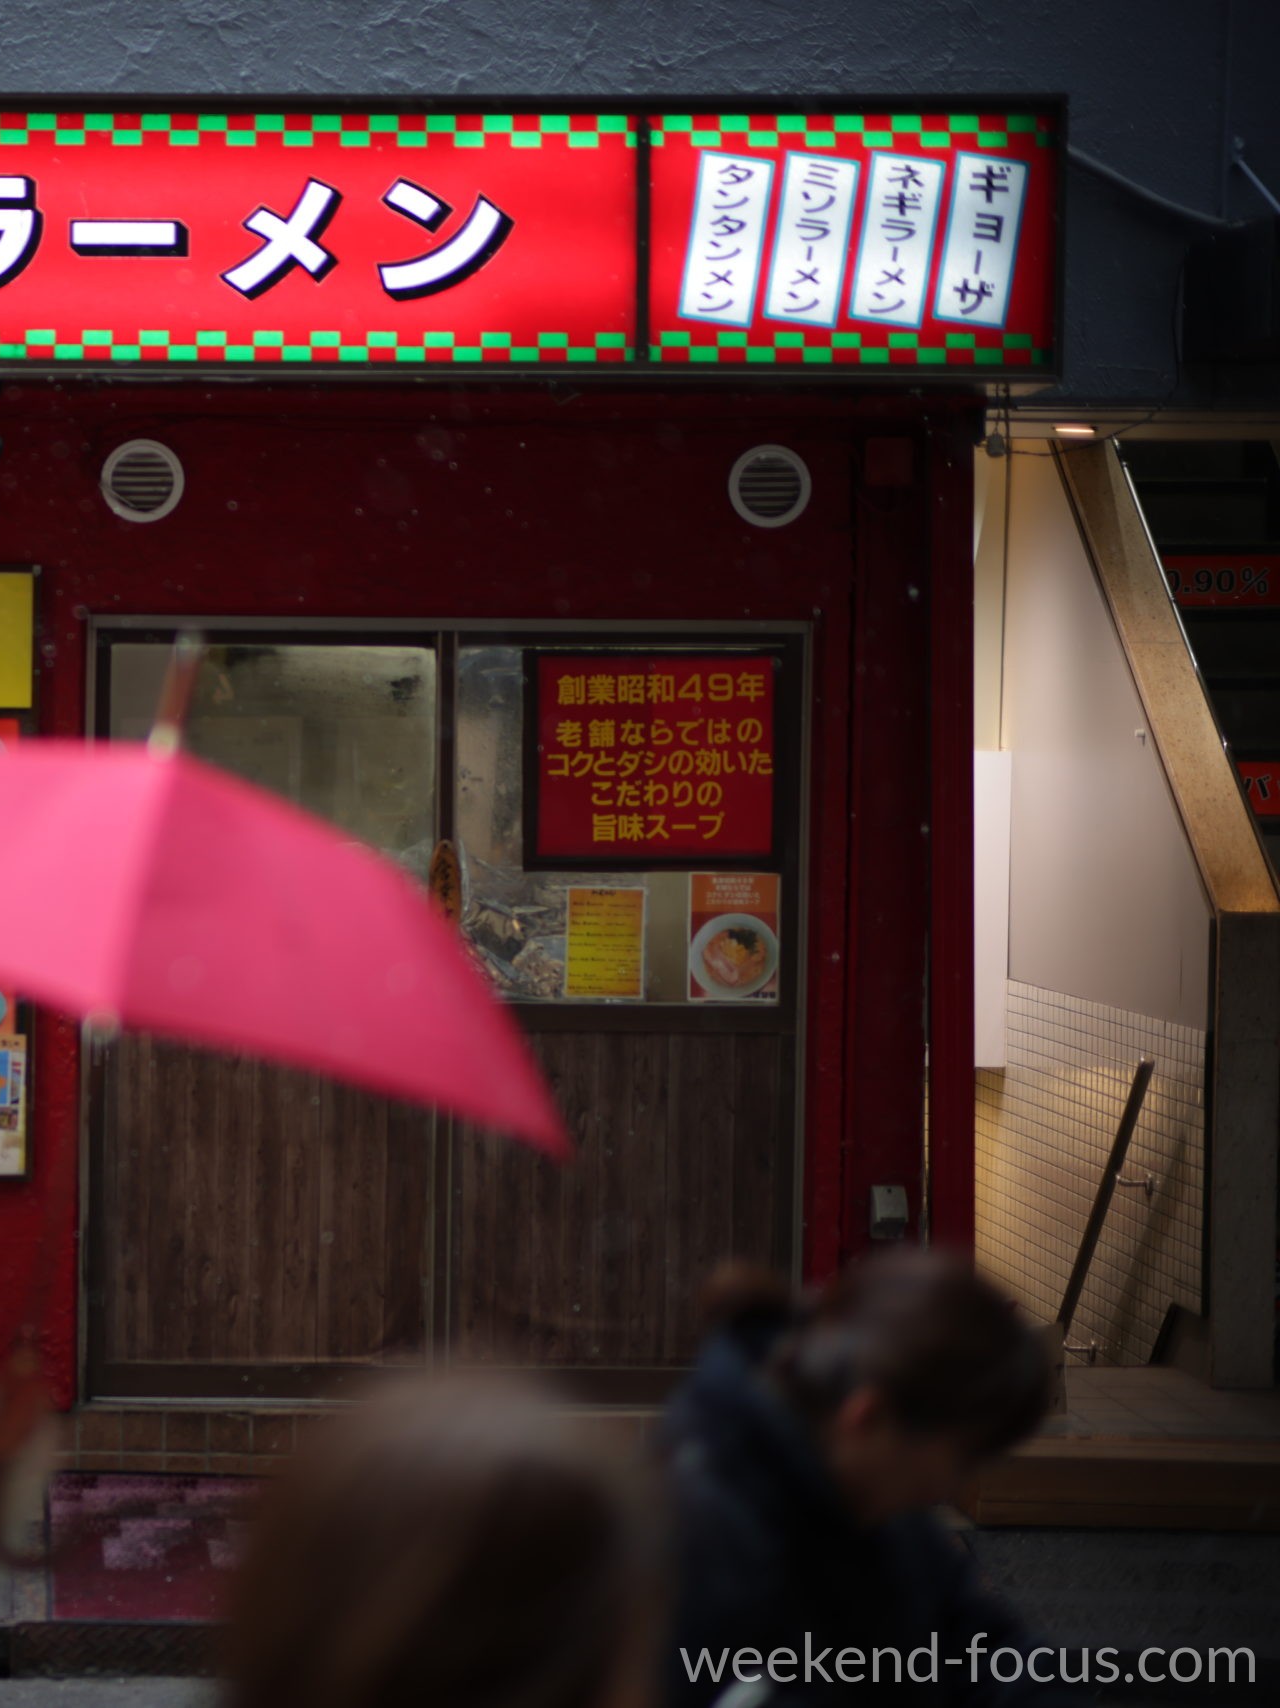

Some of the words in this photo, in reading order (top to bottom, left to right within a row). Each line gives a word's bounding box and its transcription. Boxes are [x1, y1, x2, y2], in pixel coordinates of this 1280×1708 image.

[697, 163, 755, 313] タンタンメン
[783, 163, 839, 314] ミソラーメン
[868, 163, 924, 315] ネギラーメン
[557, 672, 766, 705] 創業昭和49年
[555, 718, 763, 748] 老舗ならではの
[547, 748, 775, 777] コクとダシの効いた
[591, 780, 723, 808] こだわりの
[592, 812, 725, 841] 旨味スープ
